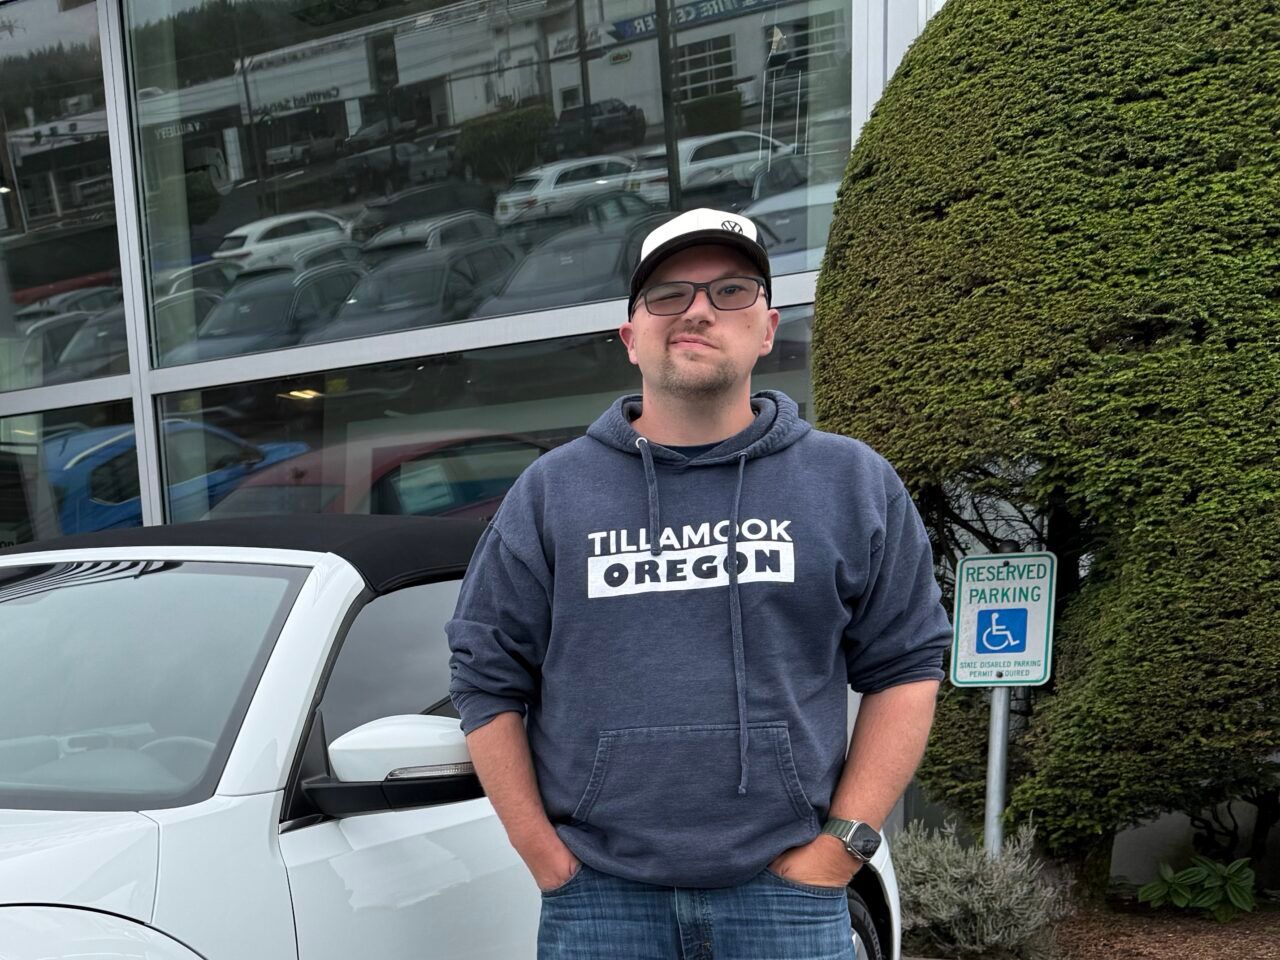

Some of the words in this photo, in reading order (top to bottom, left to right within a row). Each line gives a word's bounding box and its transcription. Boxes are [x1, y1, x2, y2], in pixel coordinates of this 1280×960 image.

[588, 518, 792, 555] TILLAMOOK
[604, 549, 781, 587] OREGON
[966, 563, 1047, 582] RESERVED
[969, 586, 1041, 604] PARKING
[960, 661, 977, 669] STATE
[980, 660, 1011, 668] DISABLED
[1014, 660, 1041, 668] PARKING
[969, 670, 993, 678] PERMIT
[996, 669, 1030, 677] EQUIRED
